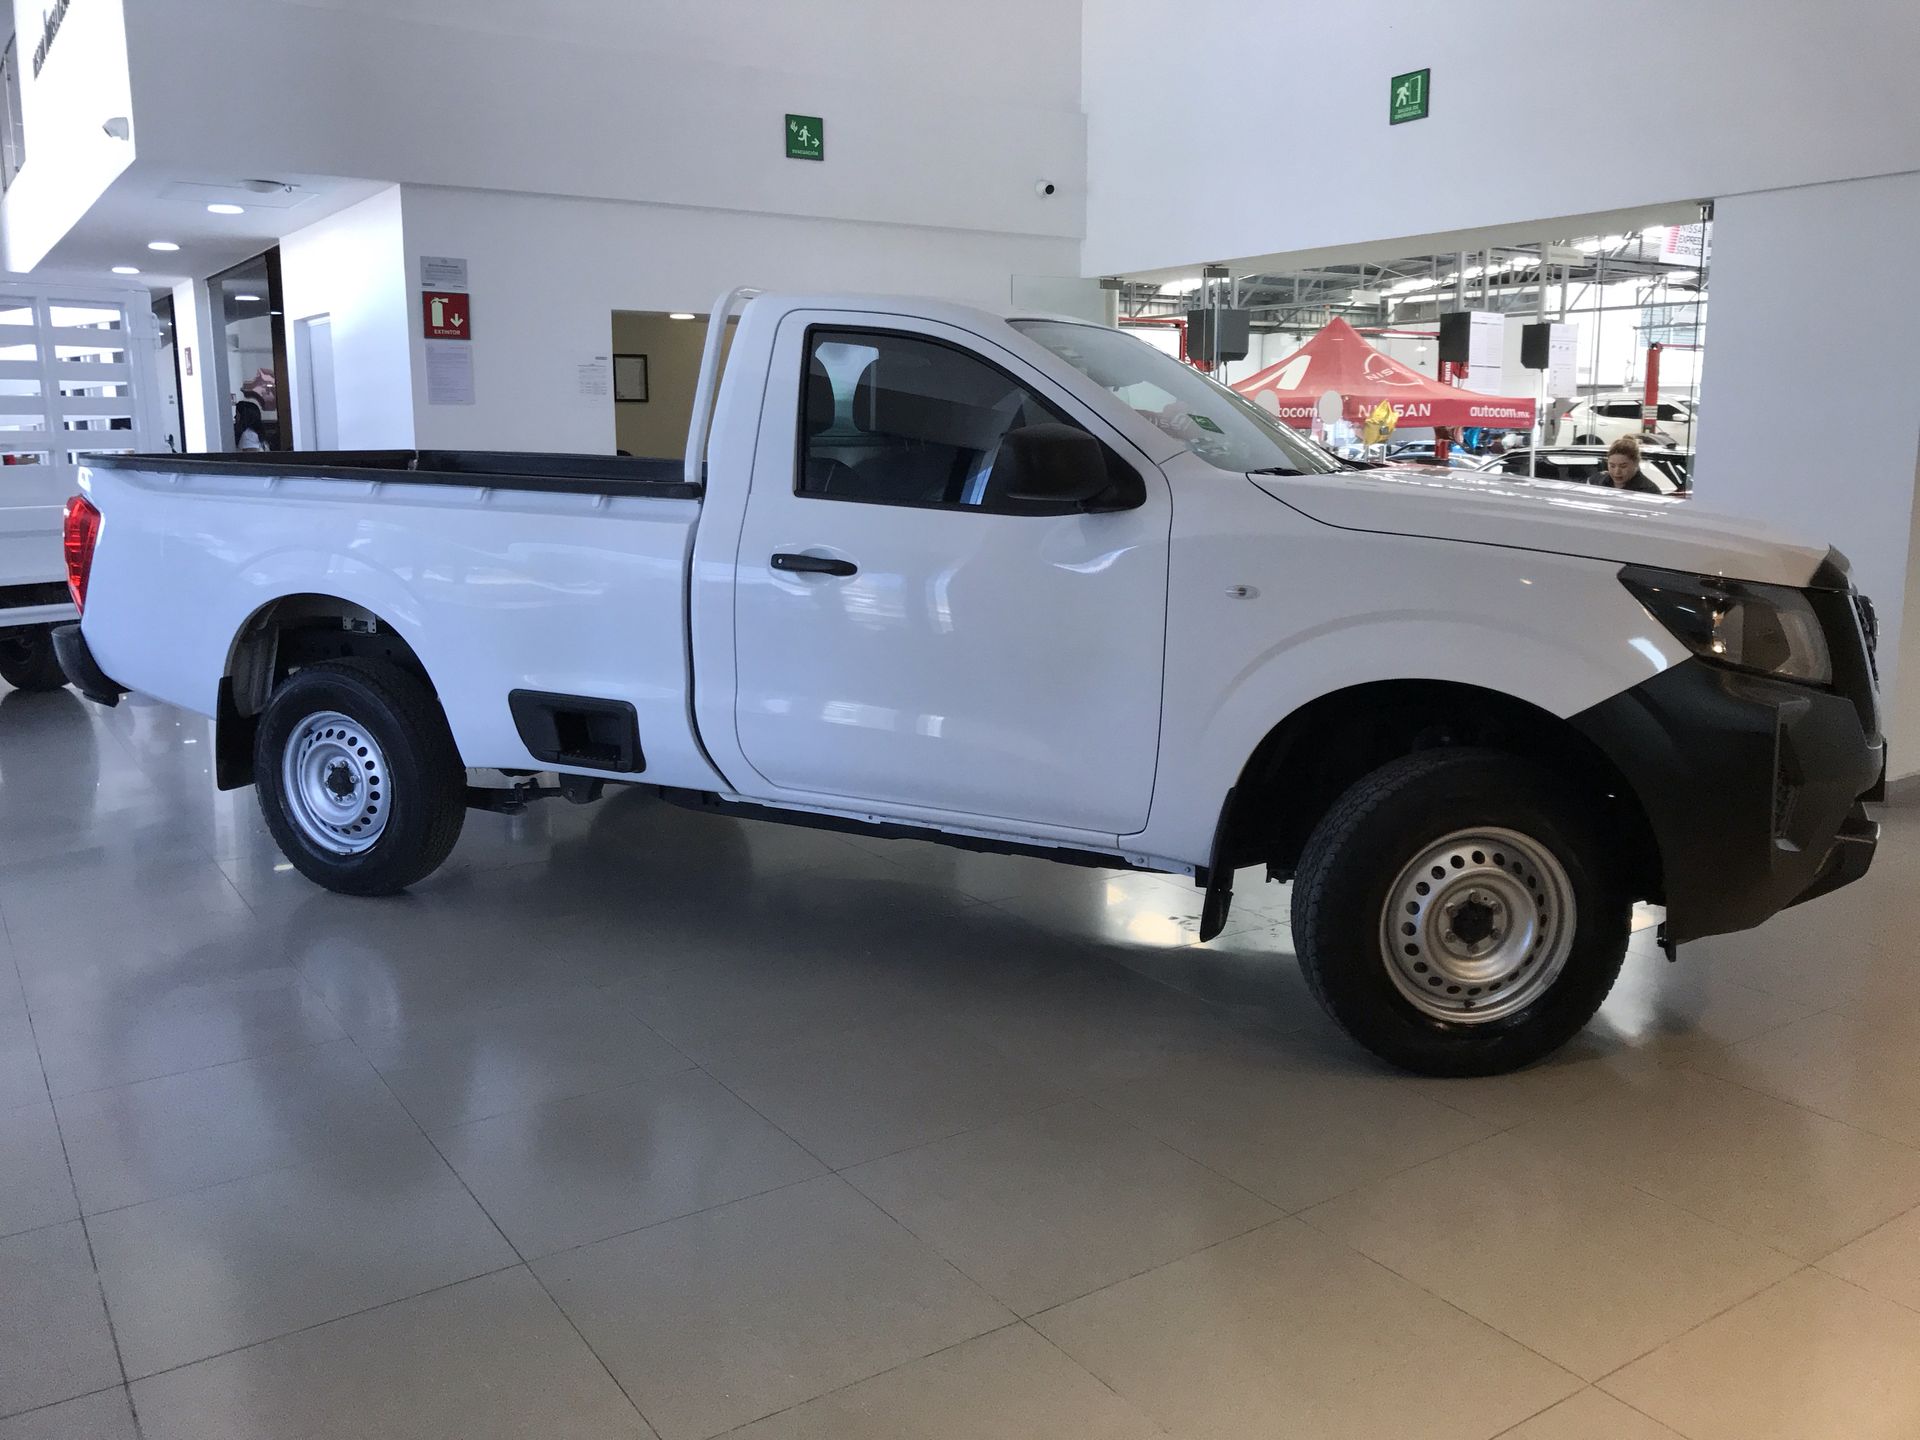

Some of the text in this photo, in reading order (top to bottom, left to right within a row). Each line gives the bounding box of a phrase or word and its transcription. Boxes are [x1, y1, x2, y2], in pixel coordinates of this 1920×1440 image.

[1678, 234, 1703, 246] EXPRES
[1278, 407, 1318, 418] tocom
[1358, 403, 1431, 418] NSAN
[1470, 405, 1530, 418] autocom.mx
